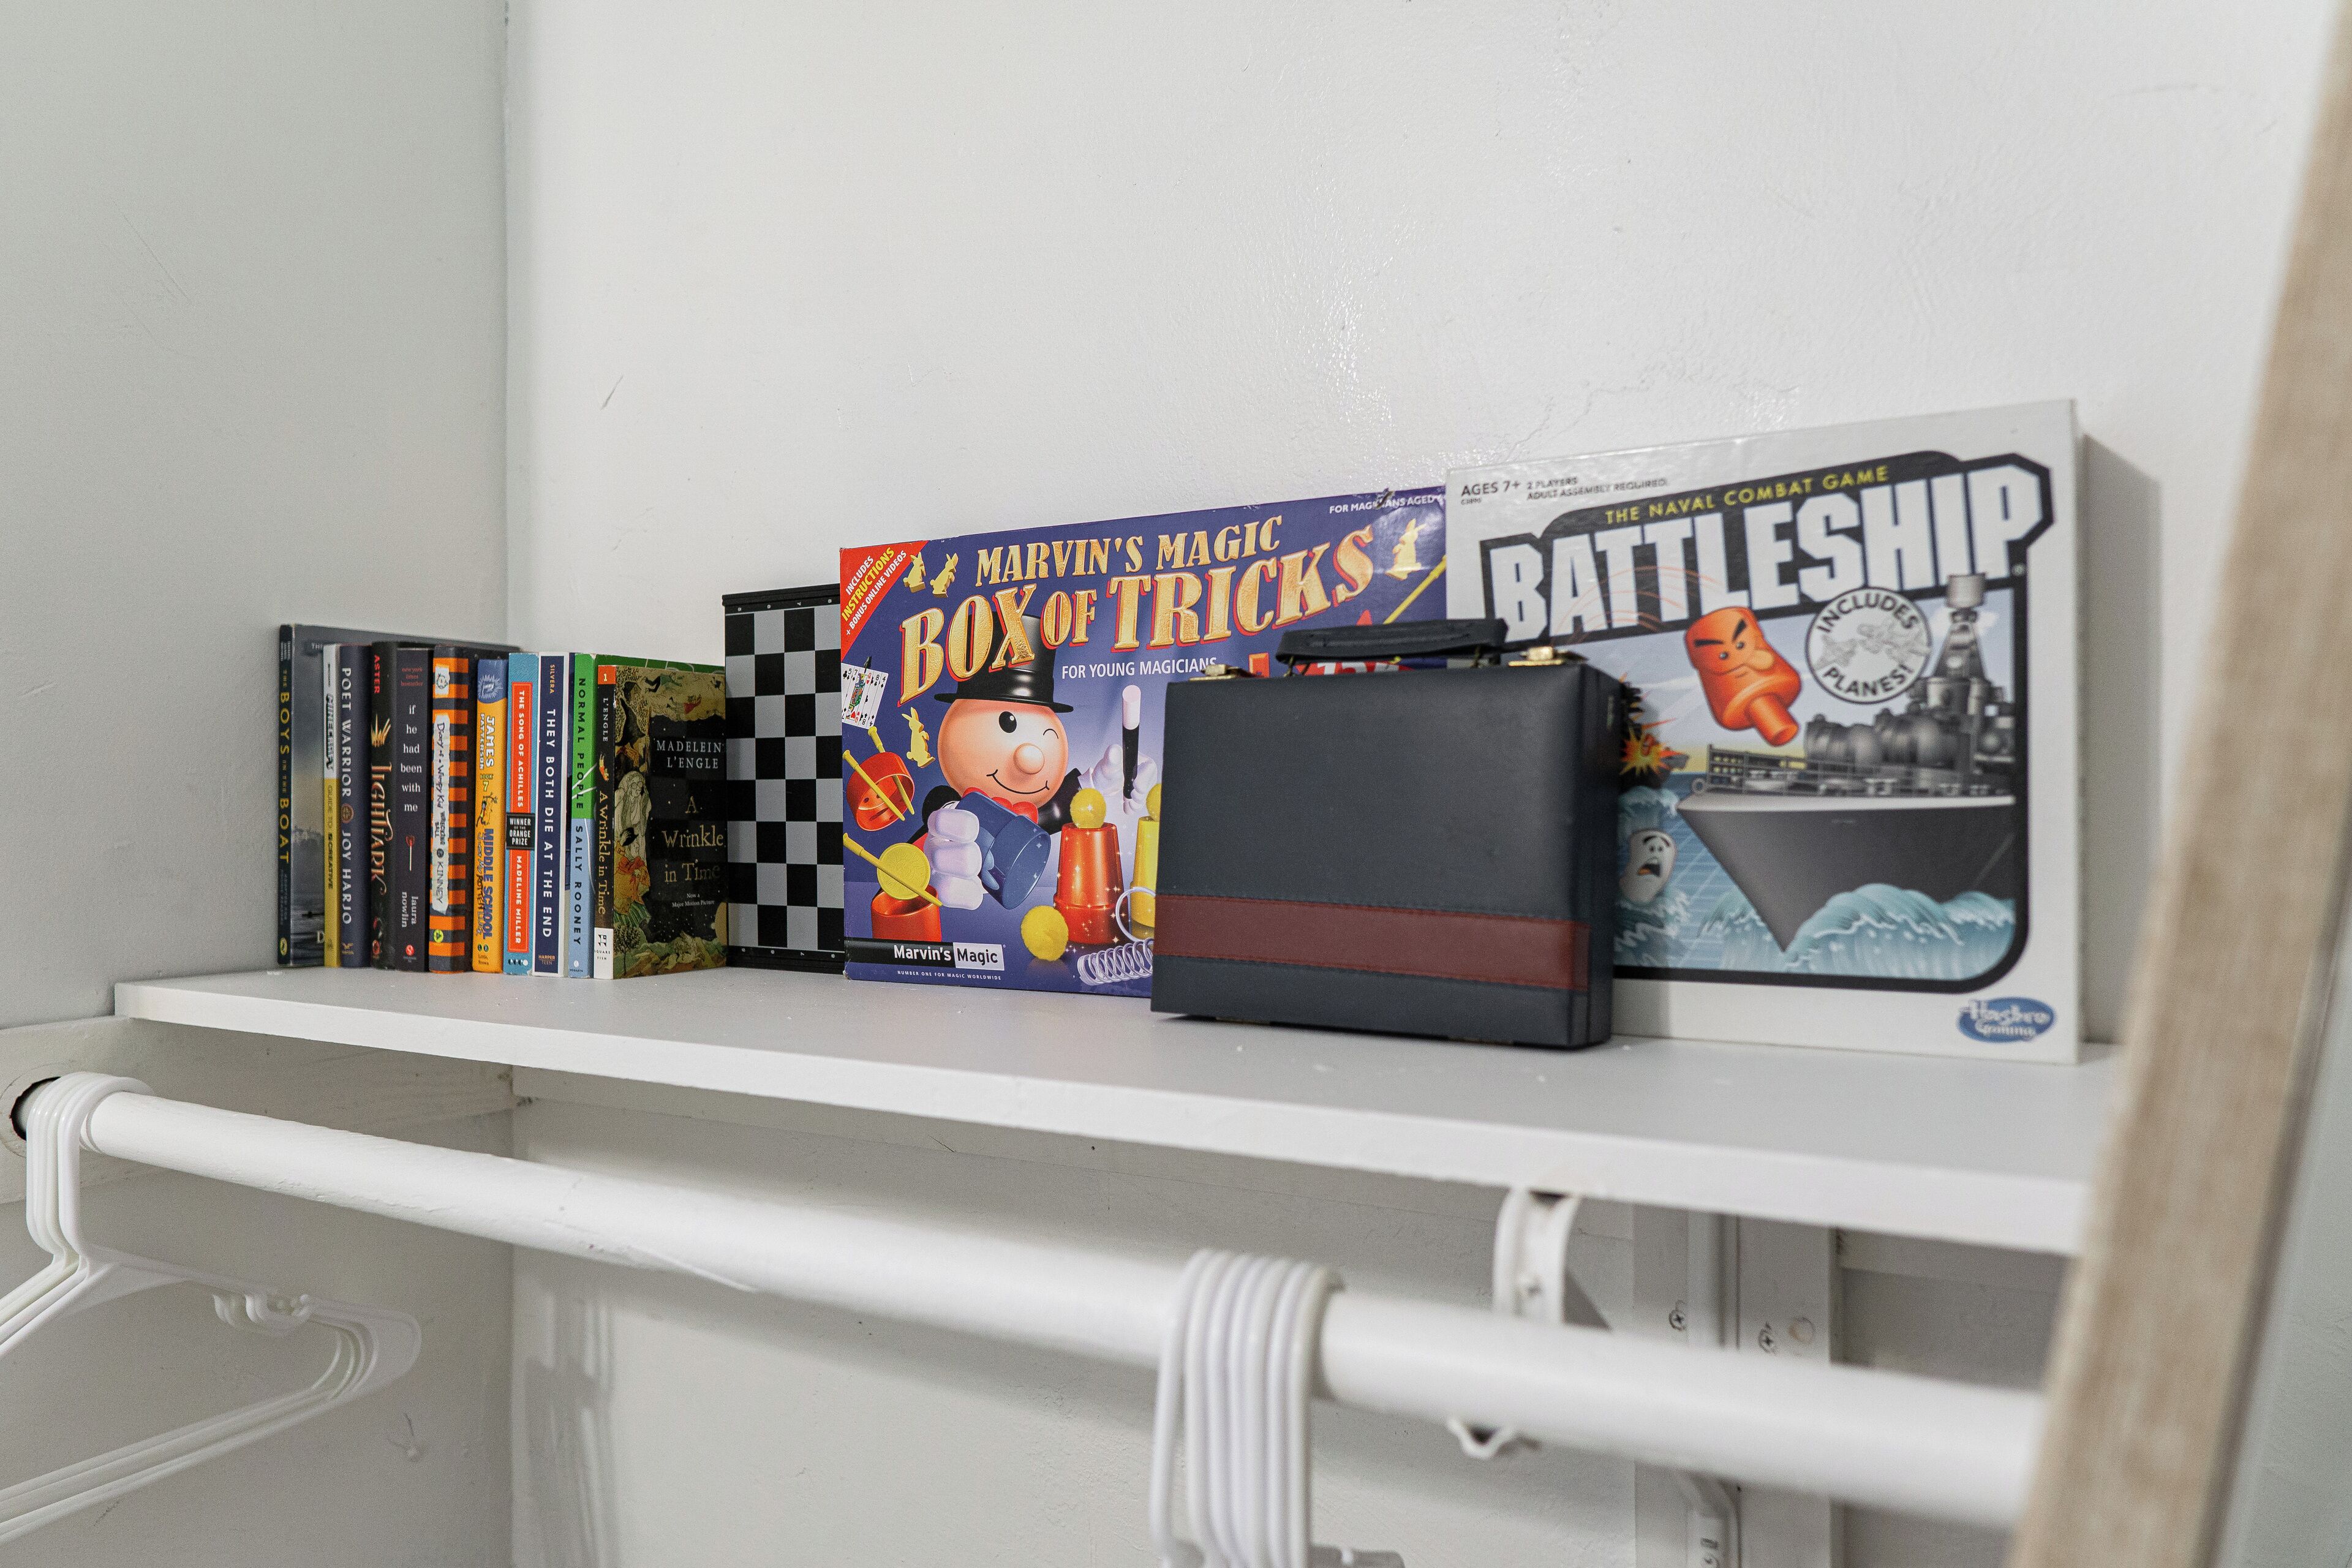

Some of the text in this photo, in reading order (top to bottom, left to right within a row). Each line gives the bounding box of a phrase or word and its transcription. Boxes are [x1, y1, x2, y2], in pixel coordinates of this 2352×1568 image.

[1460, 480, 1520, 497] AGES 7+
[1526, 489, 1558, 501] ADULT
[1534, 477, 1578, 489] PLAYERS
[1605, 464, 1890, 525] THE NAVAL COMBAT GAME
[1329, 505, 1349, 514] FOR
[1407, 495, 1434, 506] AGED
[975, 514, 1283, 587] MARVIN'S MAGIC
[1489, 464, 2043, 646] BATTLESHIP
[841, 547, 895, 622] INSTRUCTIONS
[845, 555, 874, 596] INCLUDES
[848, 602, 868, 630] BONUS
[865, 576, 887, 605] ONLINE
[883, 550, 907, 578] VIDEOS
[897, 524, 1375, 707] BOX OF TRICKS
[1817, 592, 1919, 633] INCLUDES
[603, 673, 608, 682] 1
[1061, 665, 1087, 680] FOR
[1089, 661, 1135, 678] YOUNG
[1822, 663, 1915, 696] PLANES!
[409, 704, 417, 715] if
[280, 692, 290, 755] BOYS
[342, 667, 352, 797] POET WARRIOR
[406, 724, 417, 734] he
[403, 743, 420, 754] had
[486, 715, 496, 768] JAMES
[518, 745, 524, 756] OF
[576, 678, 586, 809] NORMAL PEOPLE
[401, 763, 422, 773] been
[667, 756, 718, 769] L'ENGLE
[402, 782, 421, 793] with
[483, 780, 489, 792] 7
[404, 803, 418, 812] me
[685, 796, 699, 814] A
[279, 797, 289, 864] BOAT
[509, 817, 532, 826] WINNER
[509, 829, 531, 838] ORANGE
[542, 709, 556, 937] THEY BOTH DIE AT THE END
[511, 837, 529, 846] PRIZE
[662, 824, 723, 848] Wrinkle
[483, 828, 494, 882] MIDDLE
[598, 791, 611, 914] A Wrinkle in Time
[342, 829, 352, 924] JOY HARJO
[435, 861, 444, 904] KINNEY
[665, 859, 721, 883] in Time
[482, 886, 493, 940] SCHOOL
[573, 881, 582, 945] ROONEY
[894, 944, 998, 966] Marvin's Magic
